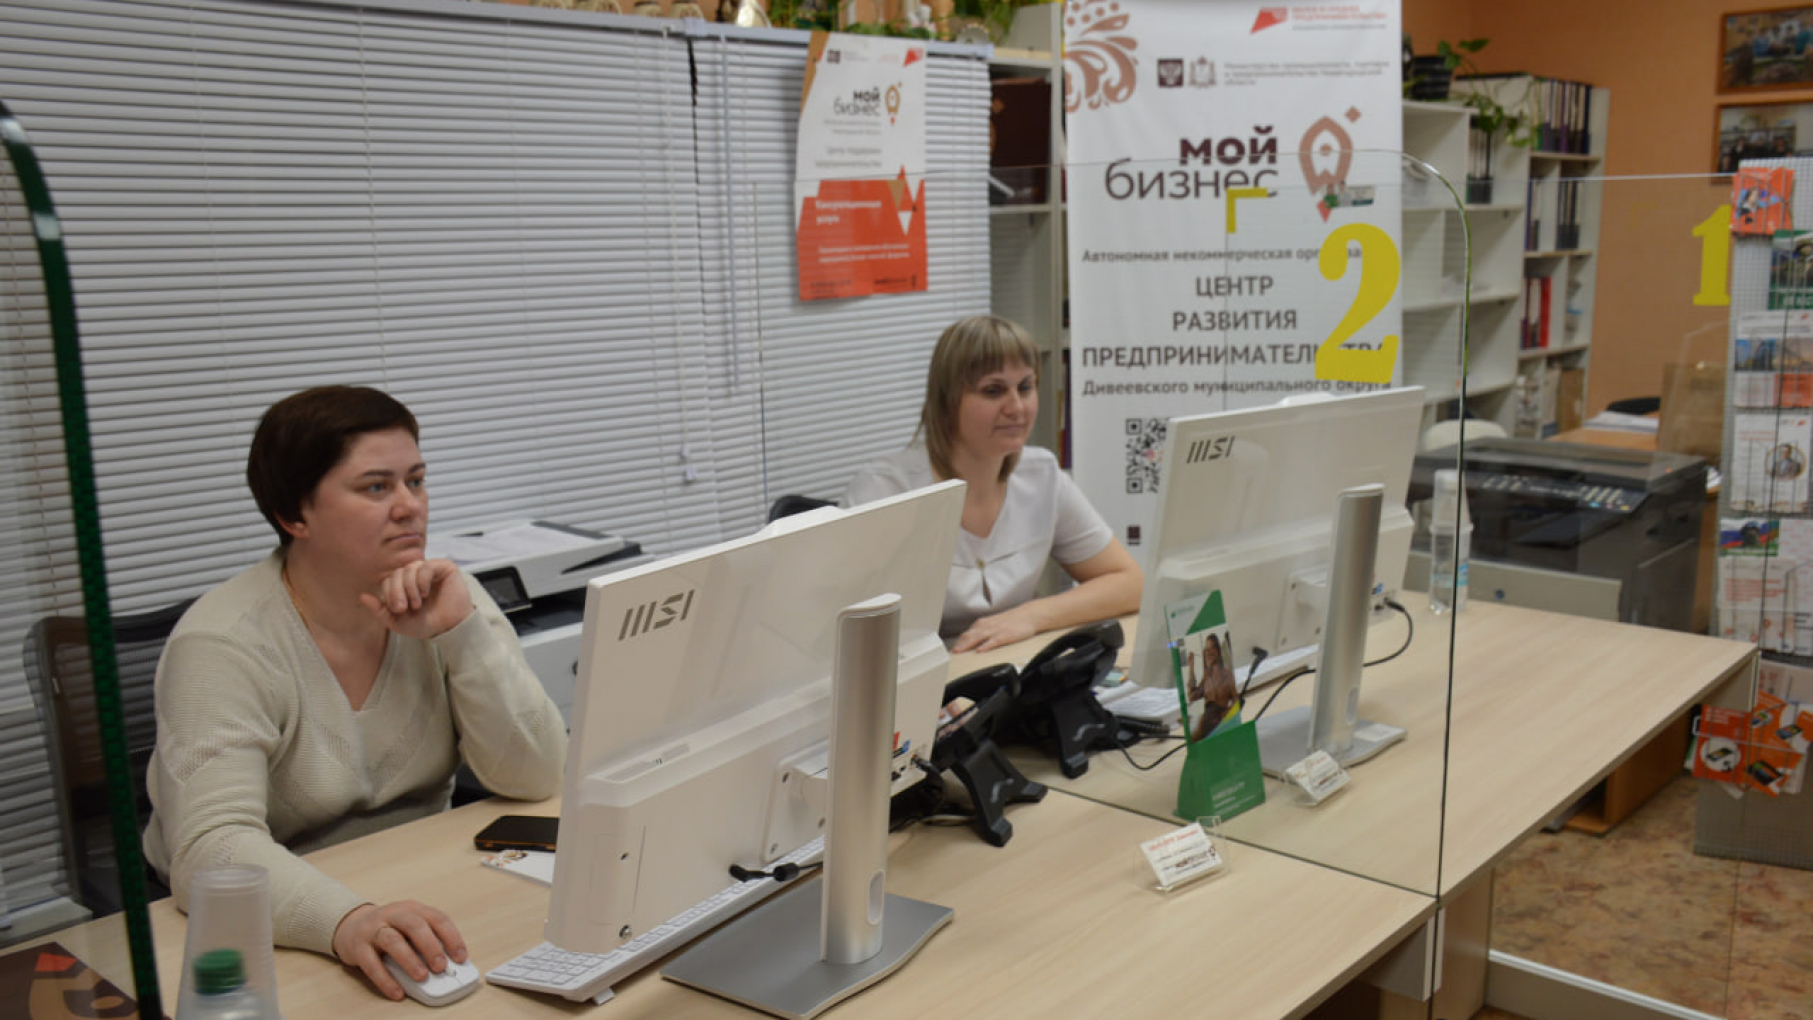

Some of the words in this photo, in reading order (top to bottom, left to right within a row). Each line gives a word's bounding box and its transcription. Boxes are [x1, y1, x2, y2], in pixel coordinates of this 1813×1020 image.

[1179, 125, 1277, 166] мой
[1105, 158, 1278, 200] бизнес
[1082, 249, 1169, 262] Автономная
[1173, 248, 1293, 262] некоммерческая
[1692, 204, 1731, 306] 1
[1196, 275, 1274, 299] ЦЕНТР
[1315, 222, 1400, 384] 2
[1173, 309, 1298, 331] РАЗВИТИЯ
[1082, 343, 1384, 369] ПРЕДПРИНИМАТЕЛ
[1082, 380, 1188, 396] Дивеевского
[1194, 380, 1331, 396] муниципального
[1187, 435, 1235, 463] MSI
[618, 589, 695, 641] MSI
